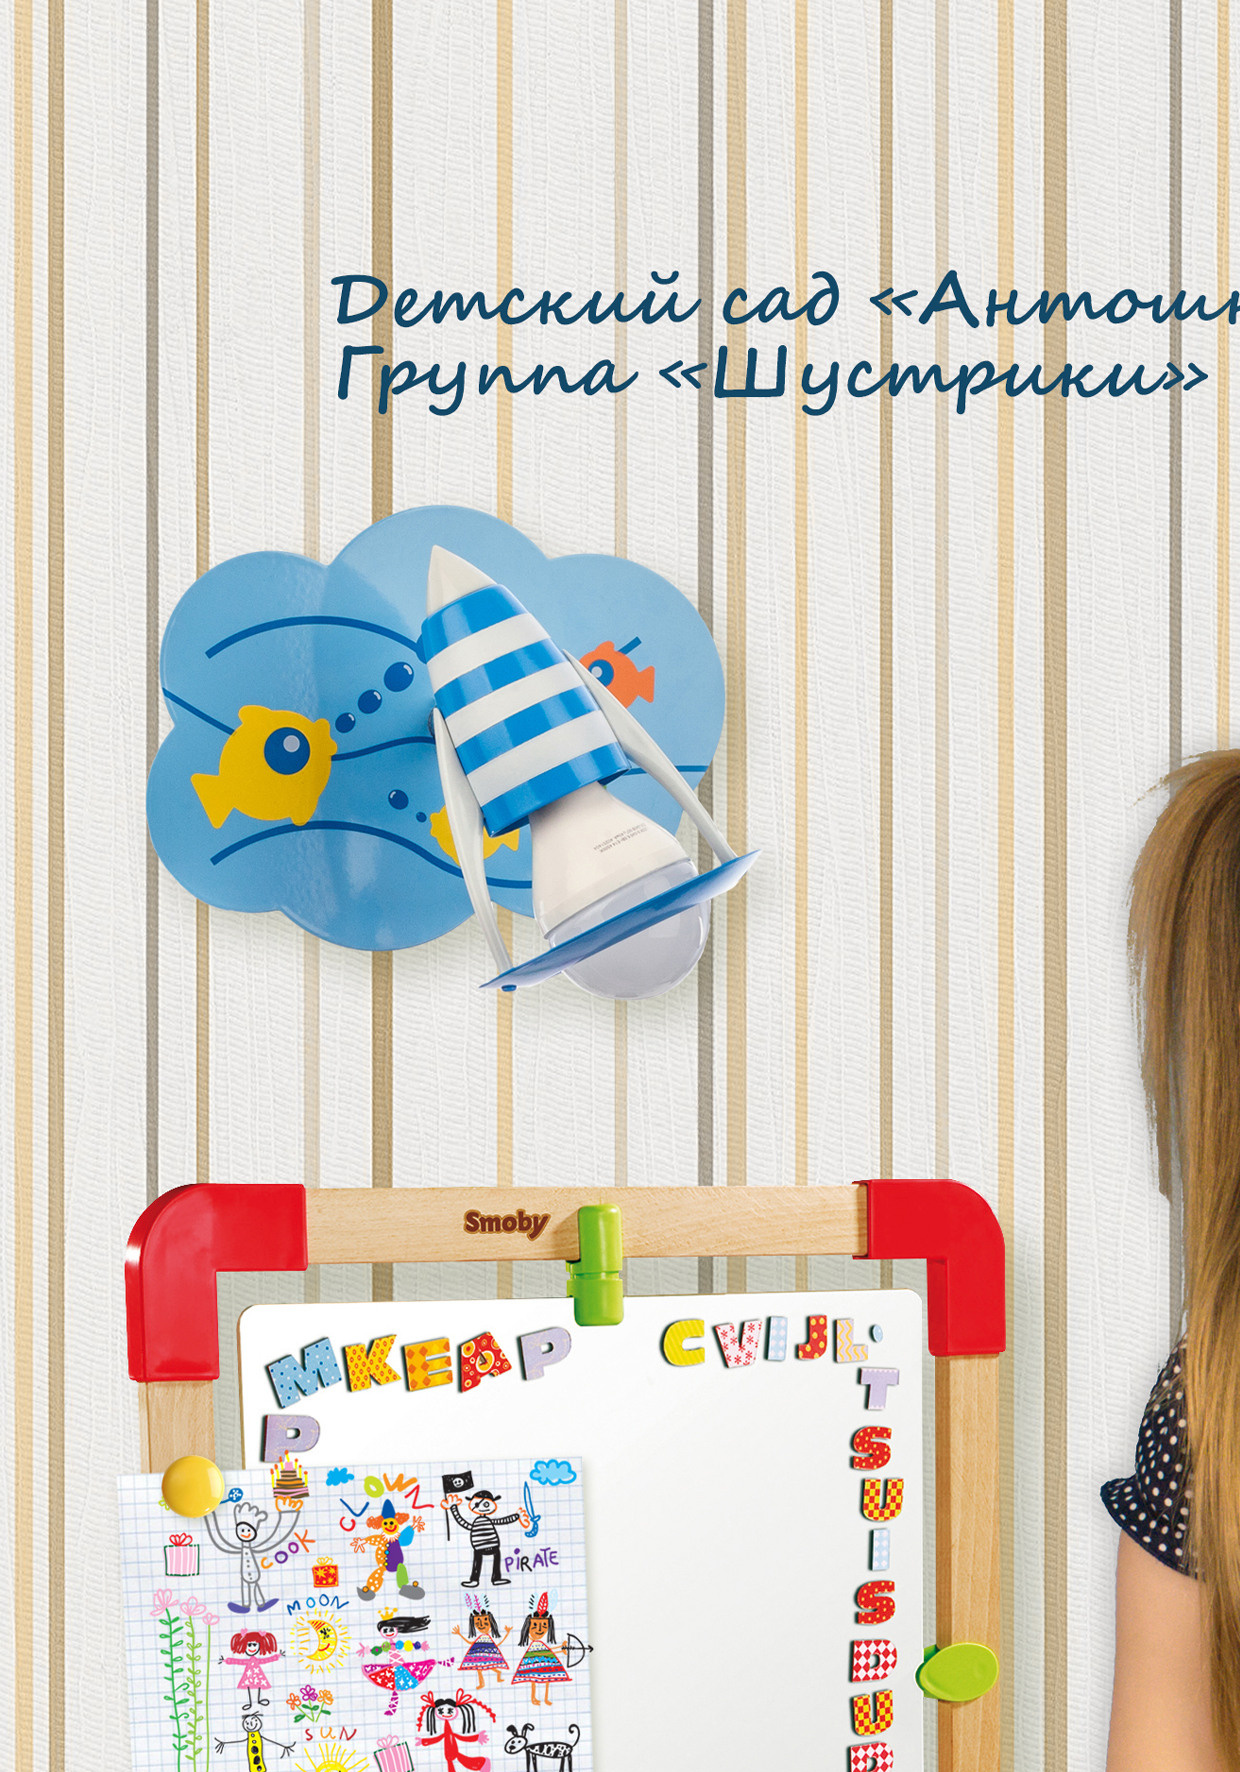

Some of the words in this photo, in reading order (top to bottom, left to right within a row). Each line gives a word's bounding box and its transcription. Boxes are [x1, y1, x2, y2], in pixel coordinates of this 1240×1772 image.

[464, 1209, 551, 1241] Smoby
[339, 1472, 435, 1532] CLOWN
[261, 1529, 316, 1569] COOK
[286, 1593, 350, 1615] MOON
